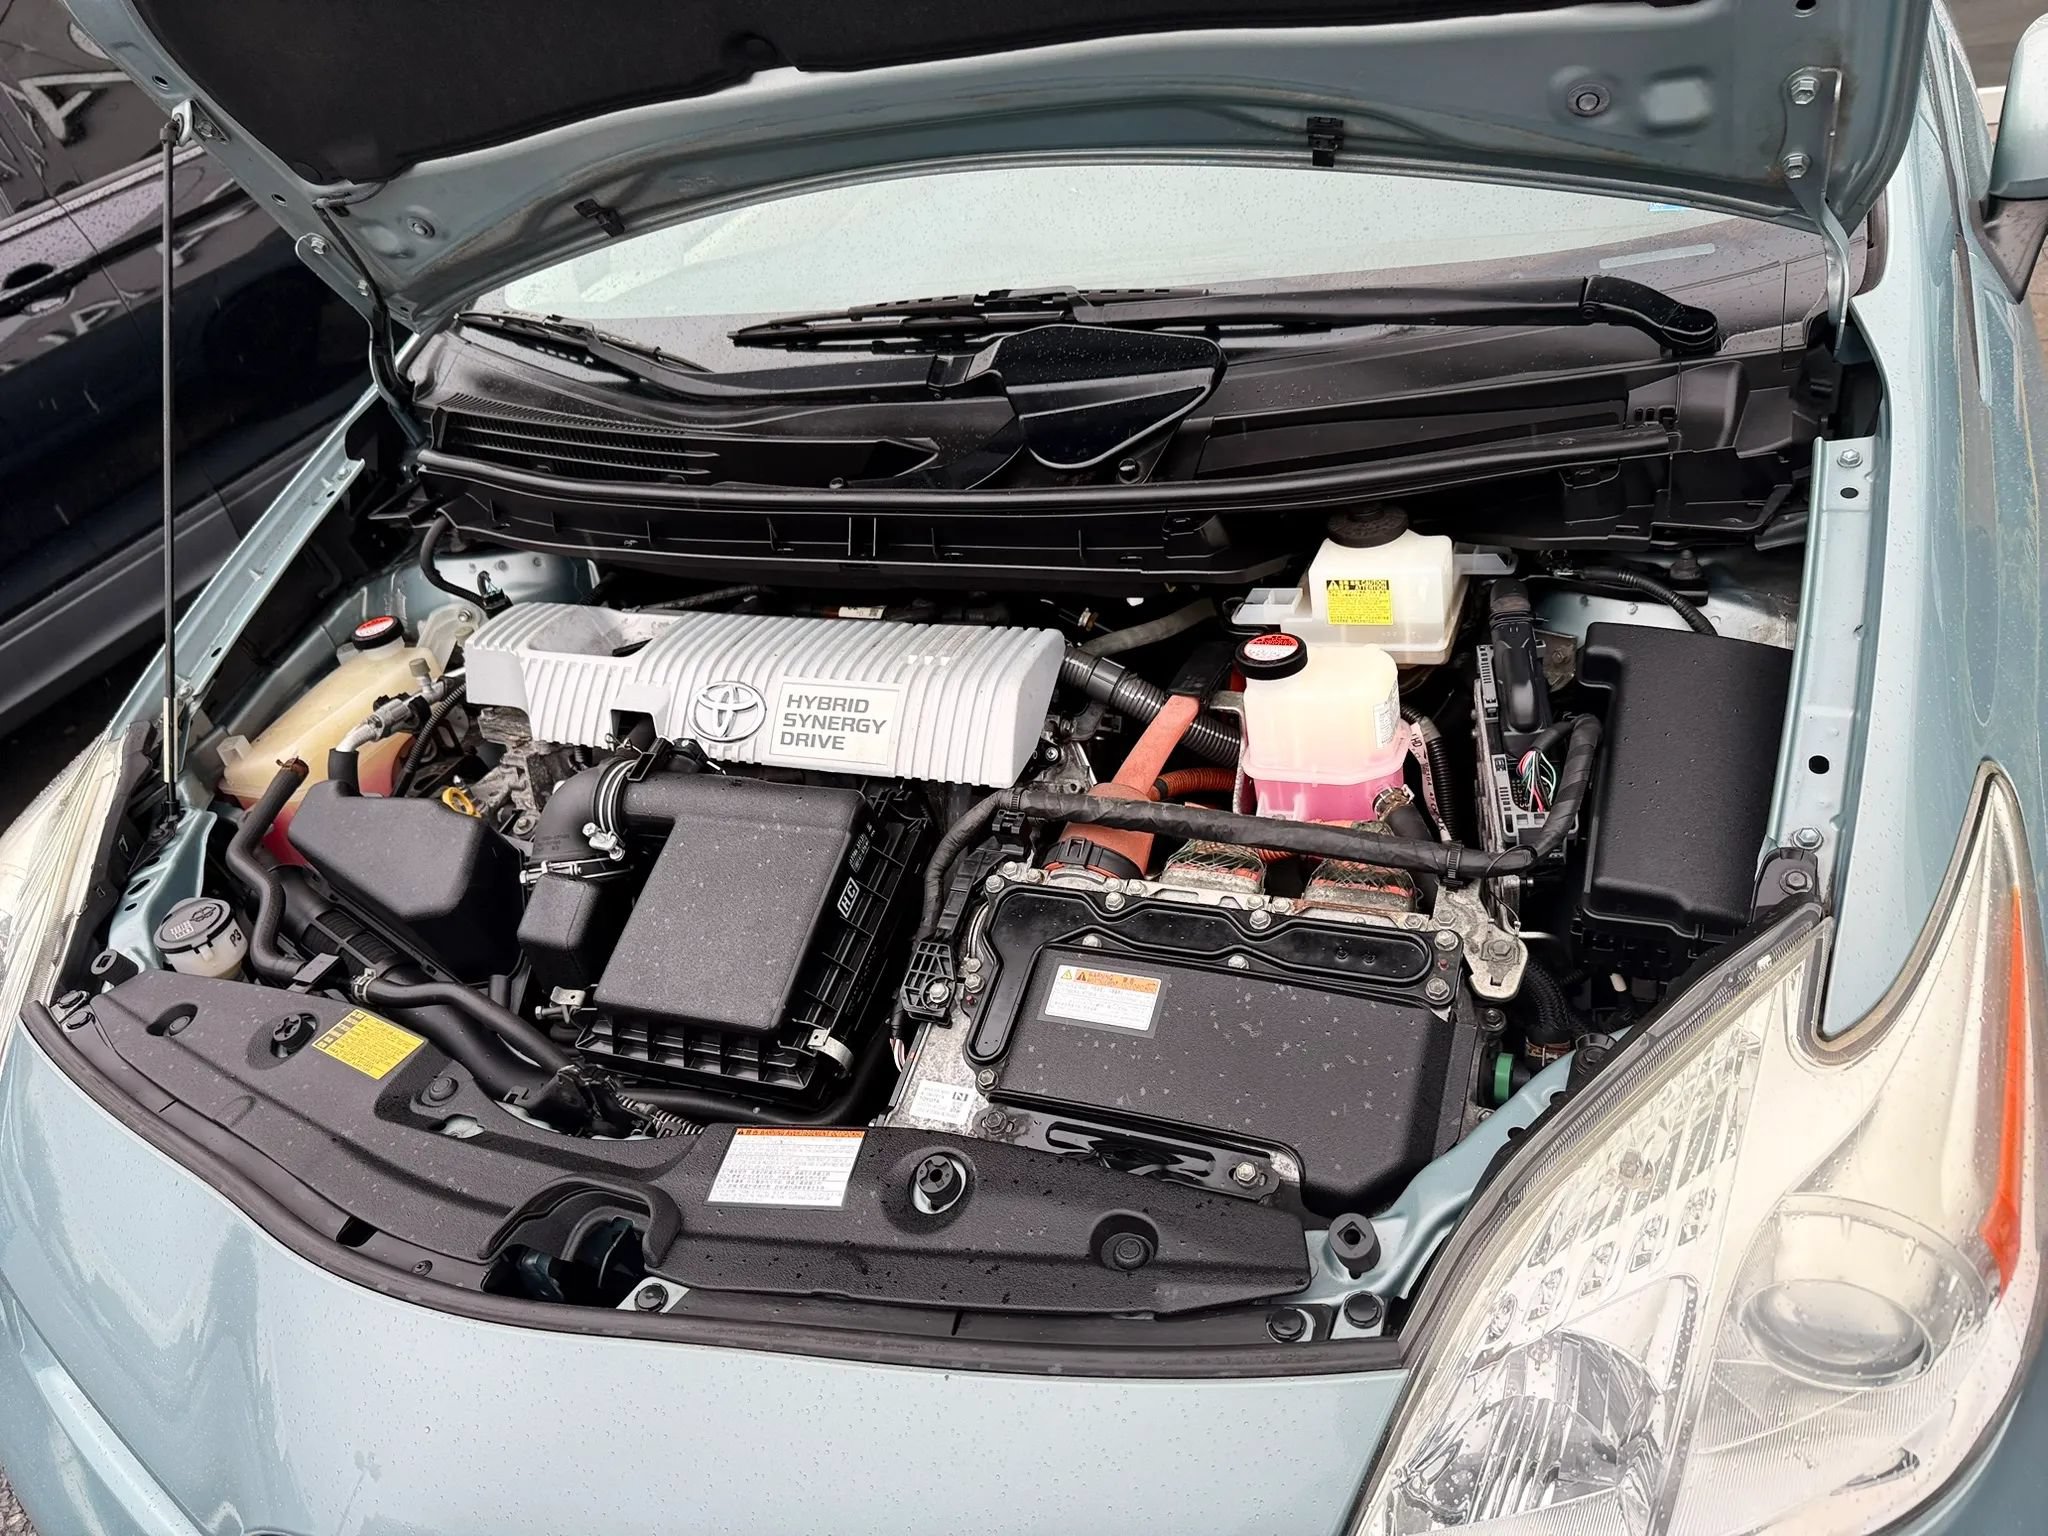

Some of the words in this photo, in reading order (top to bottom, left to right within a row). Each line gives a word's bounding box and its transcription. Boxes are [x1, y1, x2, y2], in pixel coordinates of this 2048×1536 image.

[786, 694, 869, 714] HYBRID
[783, 712, 887, 735] SYNERGY
[780, 731, 846, 751] DRIVE
[841, 886, 856, 911] HC
[229, 928, 242, 947] P3
